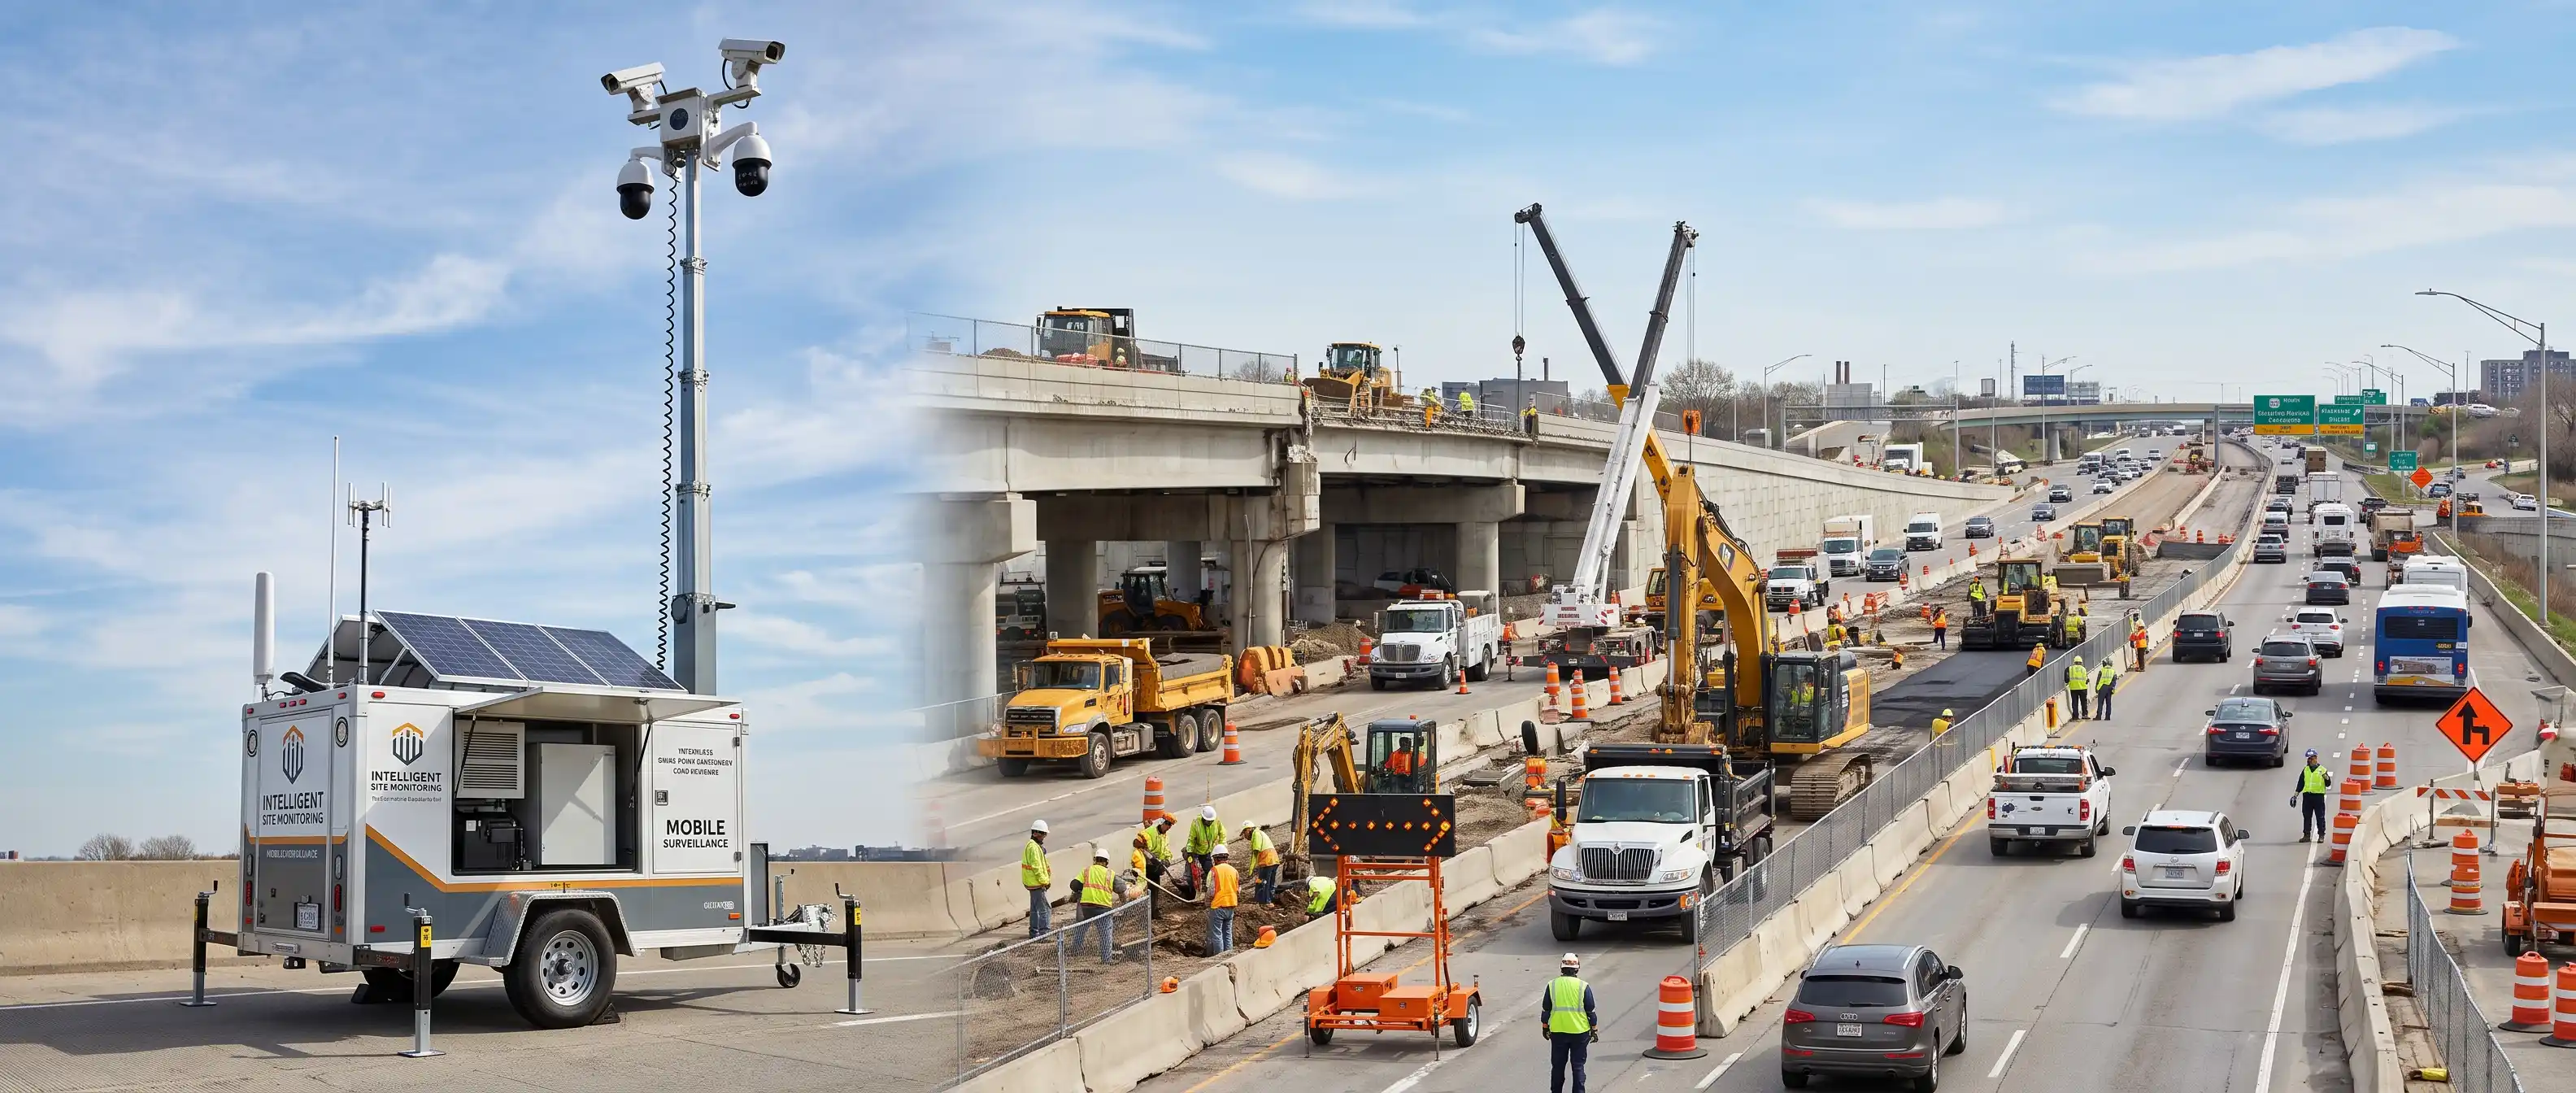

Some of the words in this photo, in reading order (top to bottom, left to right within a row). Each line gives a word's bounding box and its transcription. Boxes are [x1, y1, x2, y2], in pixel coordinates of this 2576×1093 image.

[372, 771, 442, 782] INTELLIGENT
[371, 783, 388, 791] SITE
[390, 783, 442, 792] MONITORING
[263, 791, 324, 811] INTELLIGENT
[262, 814, 276, 825] SITE
[276, 812, 324, 825] MONITORING
[667, 819, 725, 835] MOBILE
[663, 838, 729, 848] SURVEILLANCE
